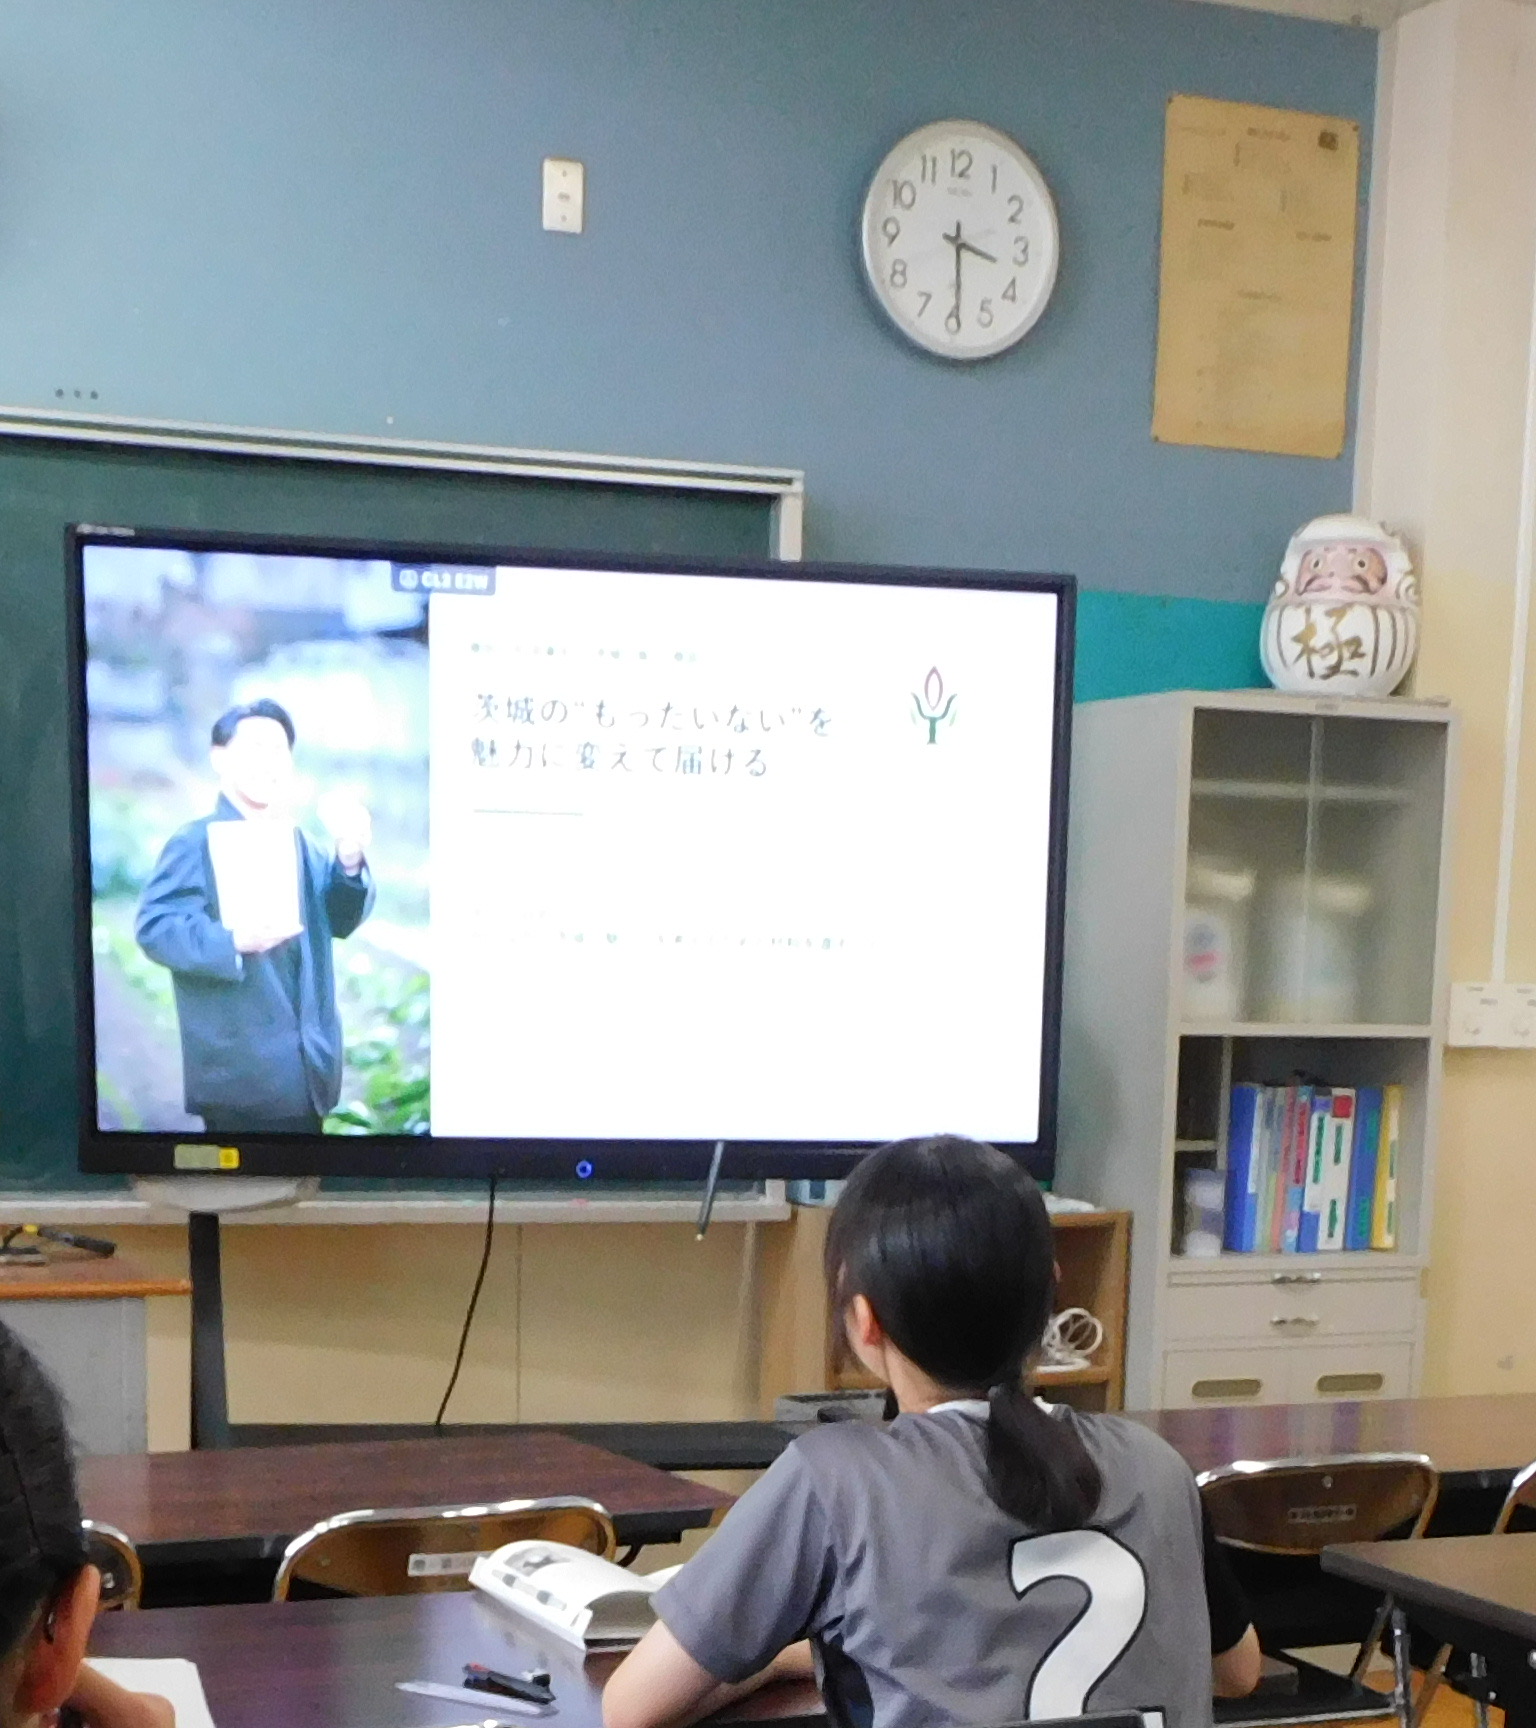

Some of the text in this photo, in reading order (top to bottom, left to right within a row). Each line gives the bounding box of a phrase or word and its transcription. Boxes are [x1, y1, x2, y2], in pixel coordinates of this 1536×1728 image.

[920, 154, 938, 186] 11
[950, 148, 974, 180] 12
[990, 164, 999, 194] 1
[892, 179, 917, 211] 10
[1007, 195, 1025, 225] 2
[881, 216, 901, 248] 9
[1012, 236, 1030, 268] 3
[889, 258, 908, 289] 8
[917, 291, 933, 318] 7
[1001, 276, 1018, 303] 4
[944, 305, 962, 336] 6
[977, 297, 995, 329] 5
